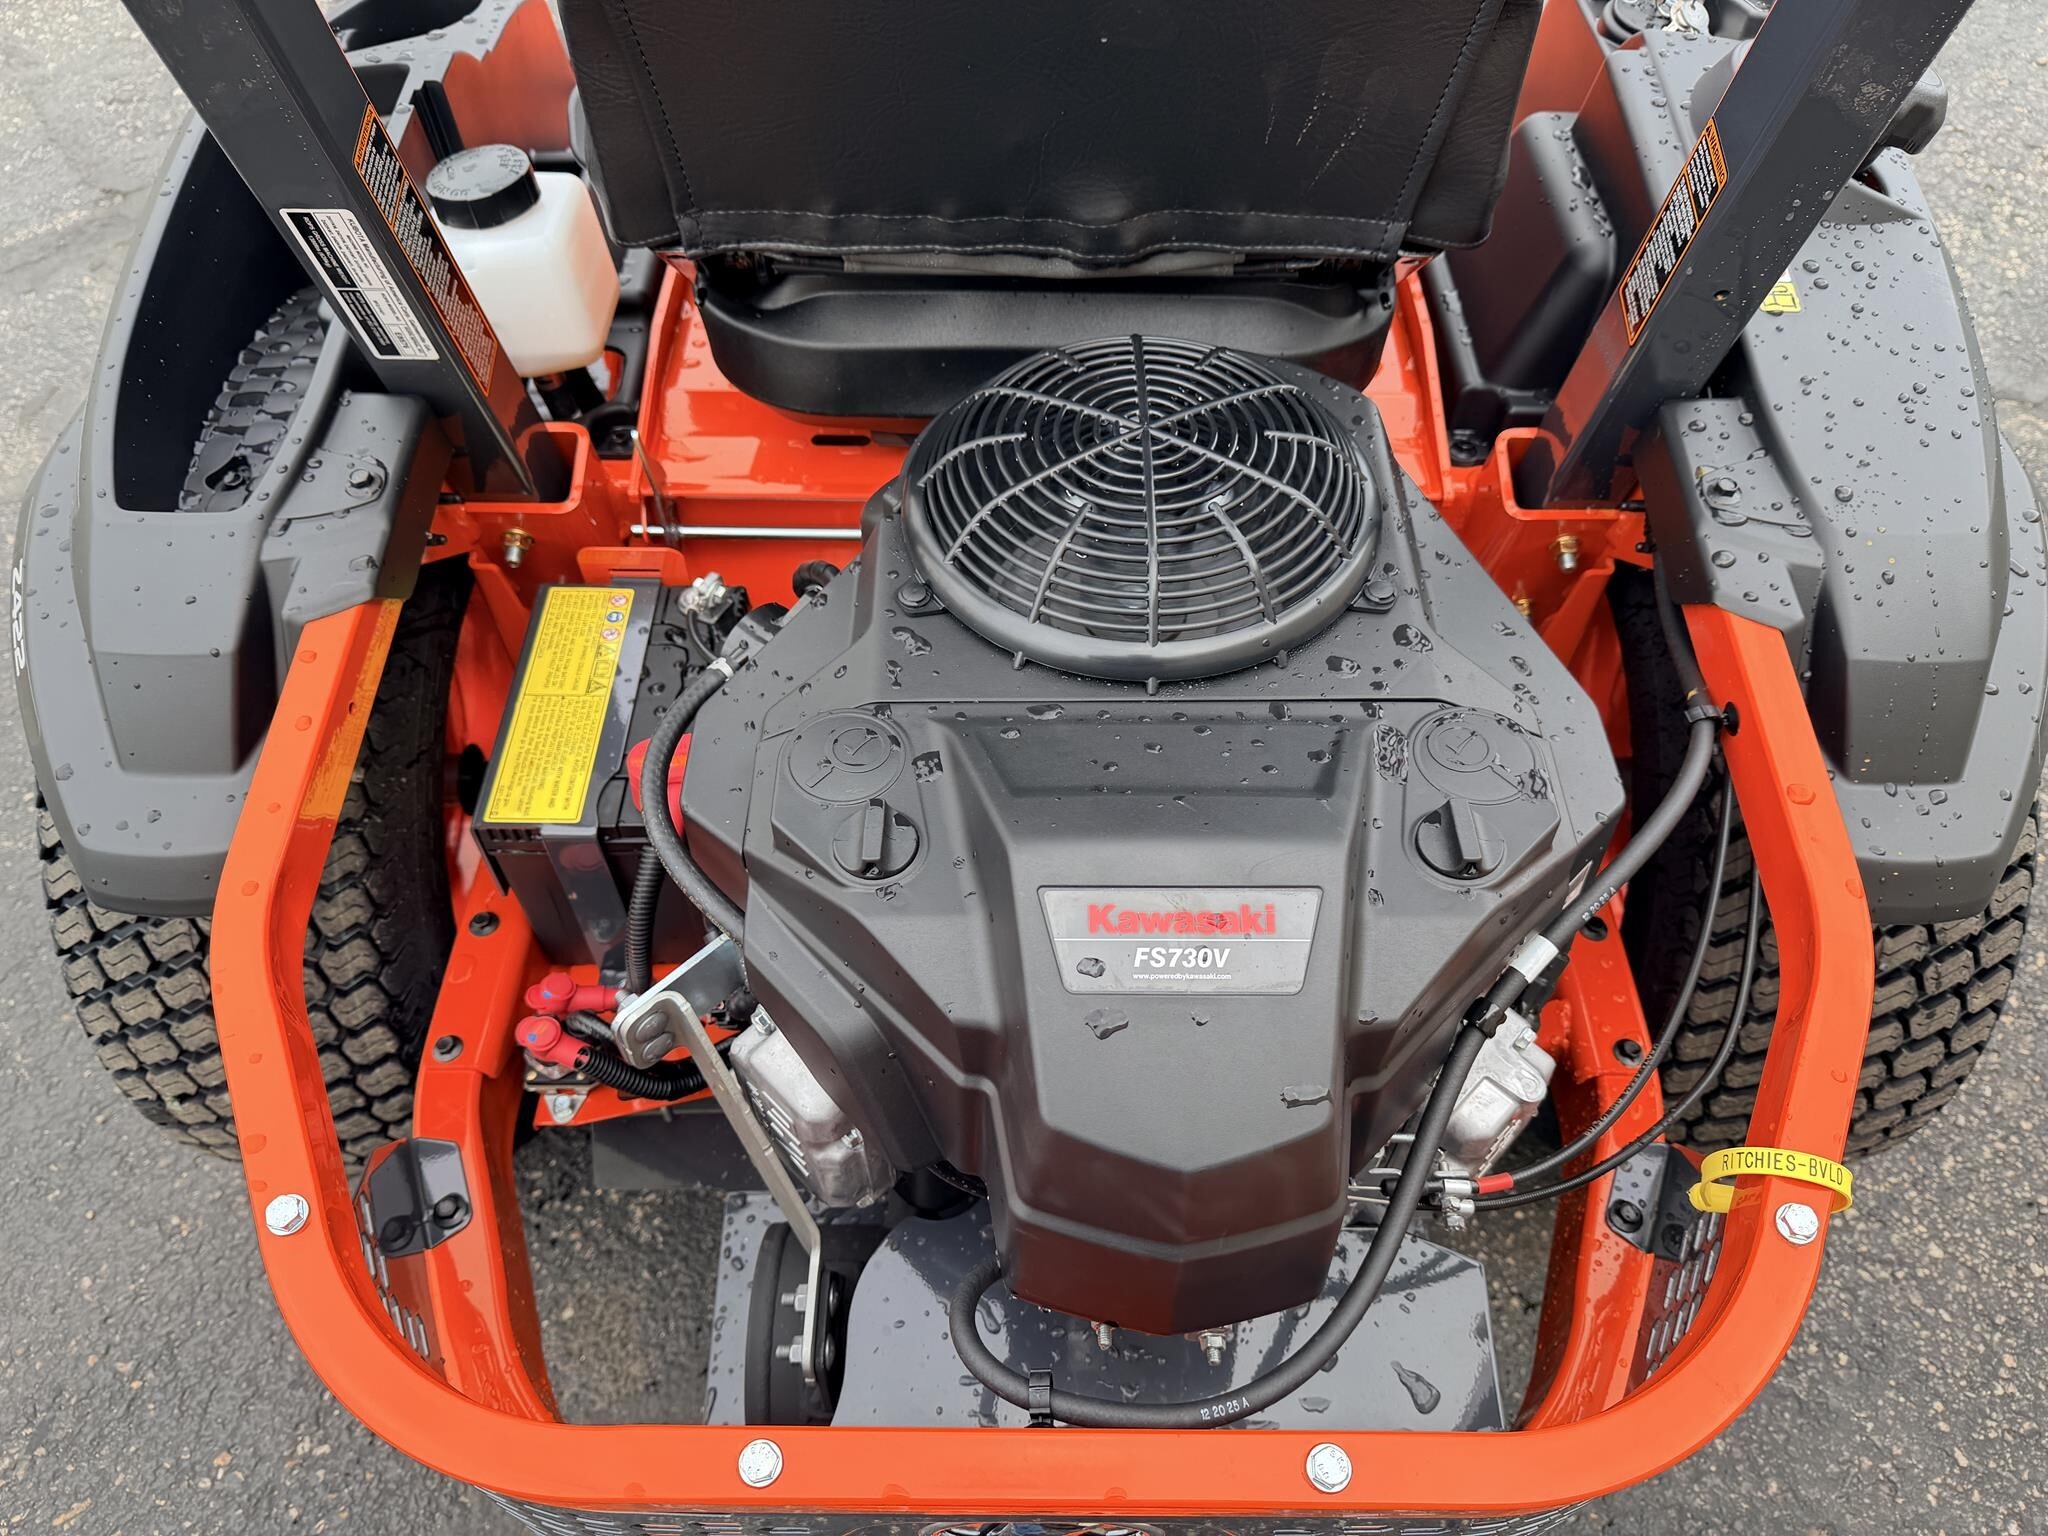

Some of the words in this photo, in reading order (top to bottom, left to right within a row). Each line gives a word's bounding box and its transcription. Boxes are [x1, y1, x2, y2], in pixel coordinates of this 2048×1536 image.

[1709, 131, 1725, 185] WARNING
[347, 218, 366, 243] KUBOTA
[362, 243, 388, 280] Manufacturing
[1087, 903, 1277, 935] Kawasaki
[1133, 947, 1231, 968] FS730V
[1133, 973, 1232, 982] www.poweredbykawasaki.com
[1722, 1151, 1844, 1187] RITCHIES-BVLD
[1200, 1408, 1211, 1420] 12
[1212, 1404, 1226, 1418] 20
[1226, 1400, 1240, 1413] 25
[1242, 1397, 1250, 1408] A
